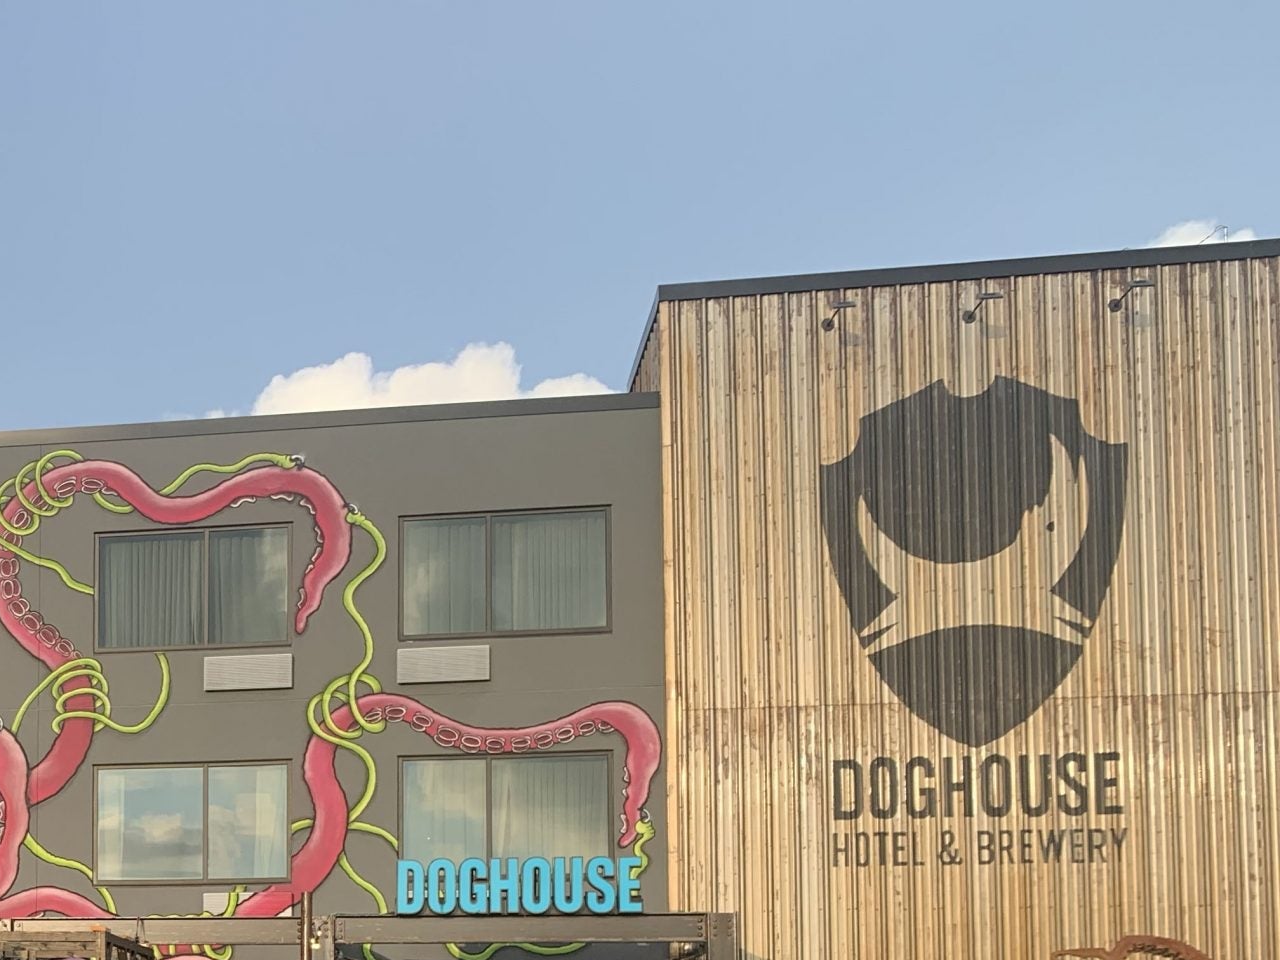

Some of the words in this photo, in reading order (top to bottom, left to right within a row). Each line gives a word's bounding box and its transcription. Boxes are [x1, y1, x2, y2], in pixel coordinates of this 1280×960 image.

[832, 751, 1125, 821] DOGHOUSE
[832, 831, 926, 868] HOTEL
[939, 829, 963, 866] &
[977, 826, 1128, 865] BREWERY
[396, 855, 644, 917] DOGHOUSE
